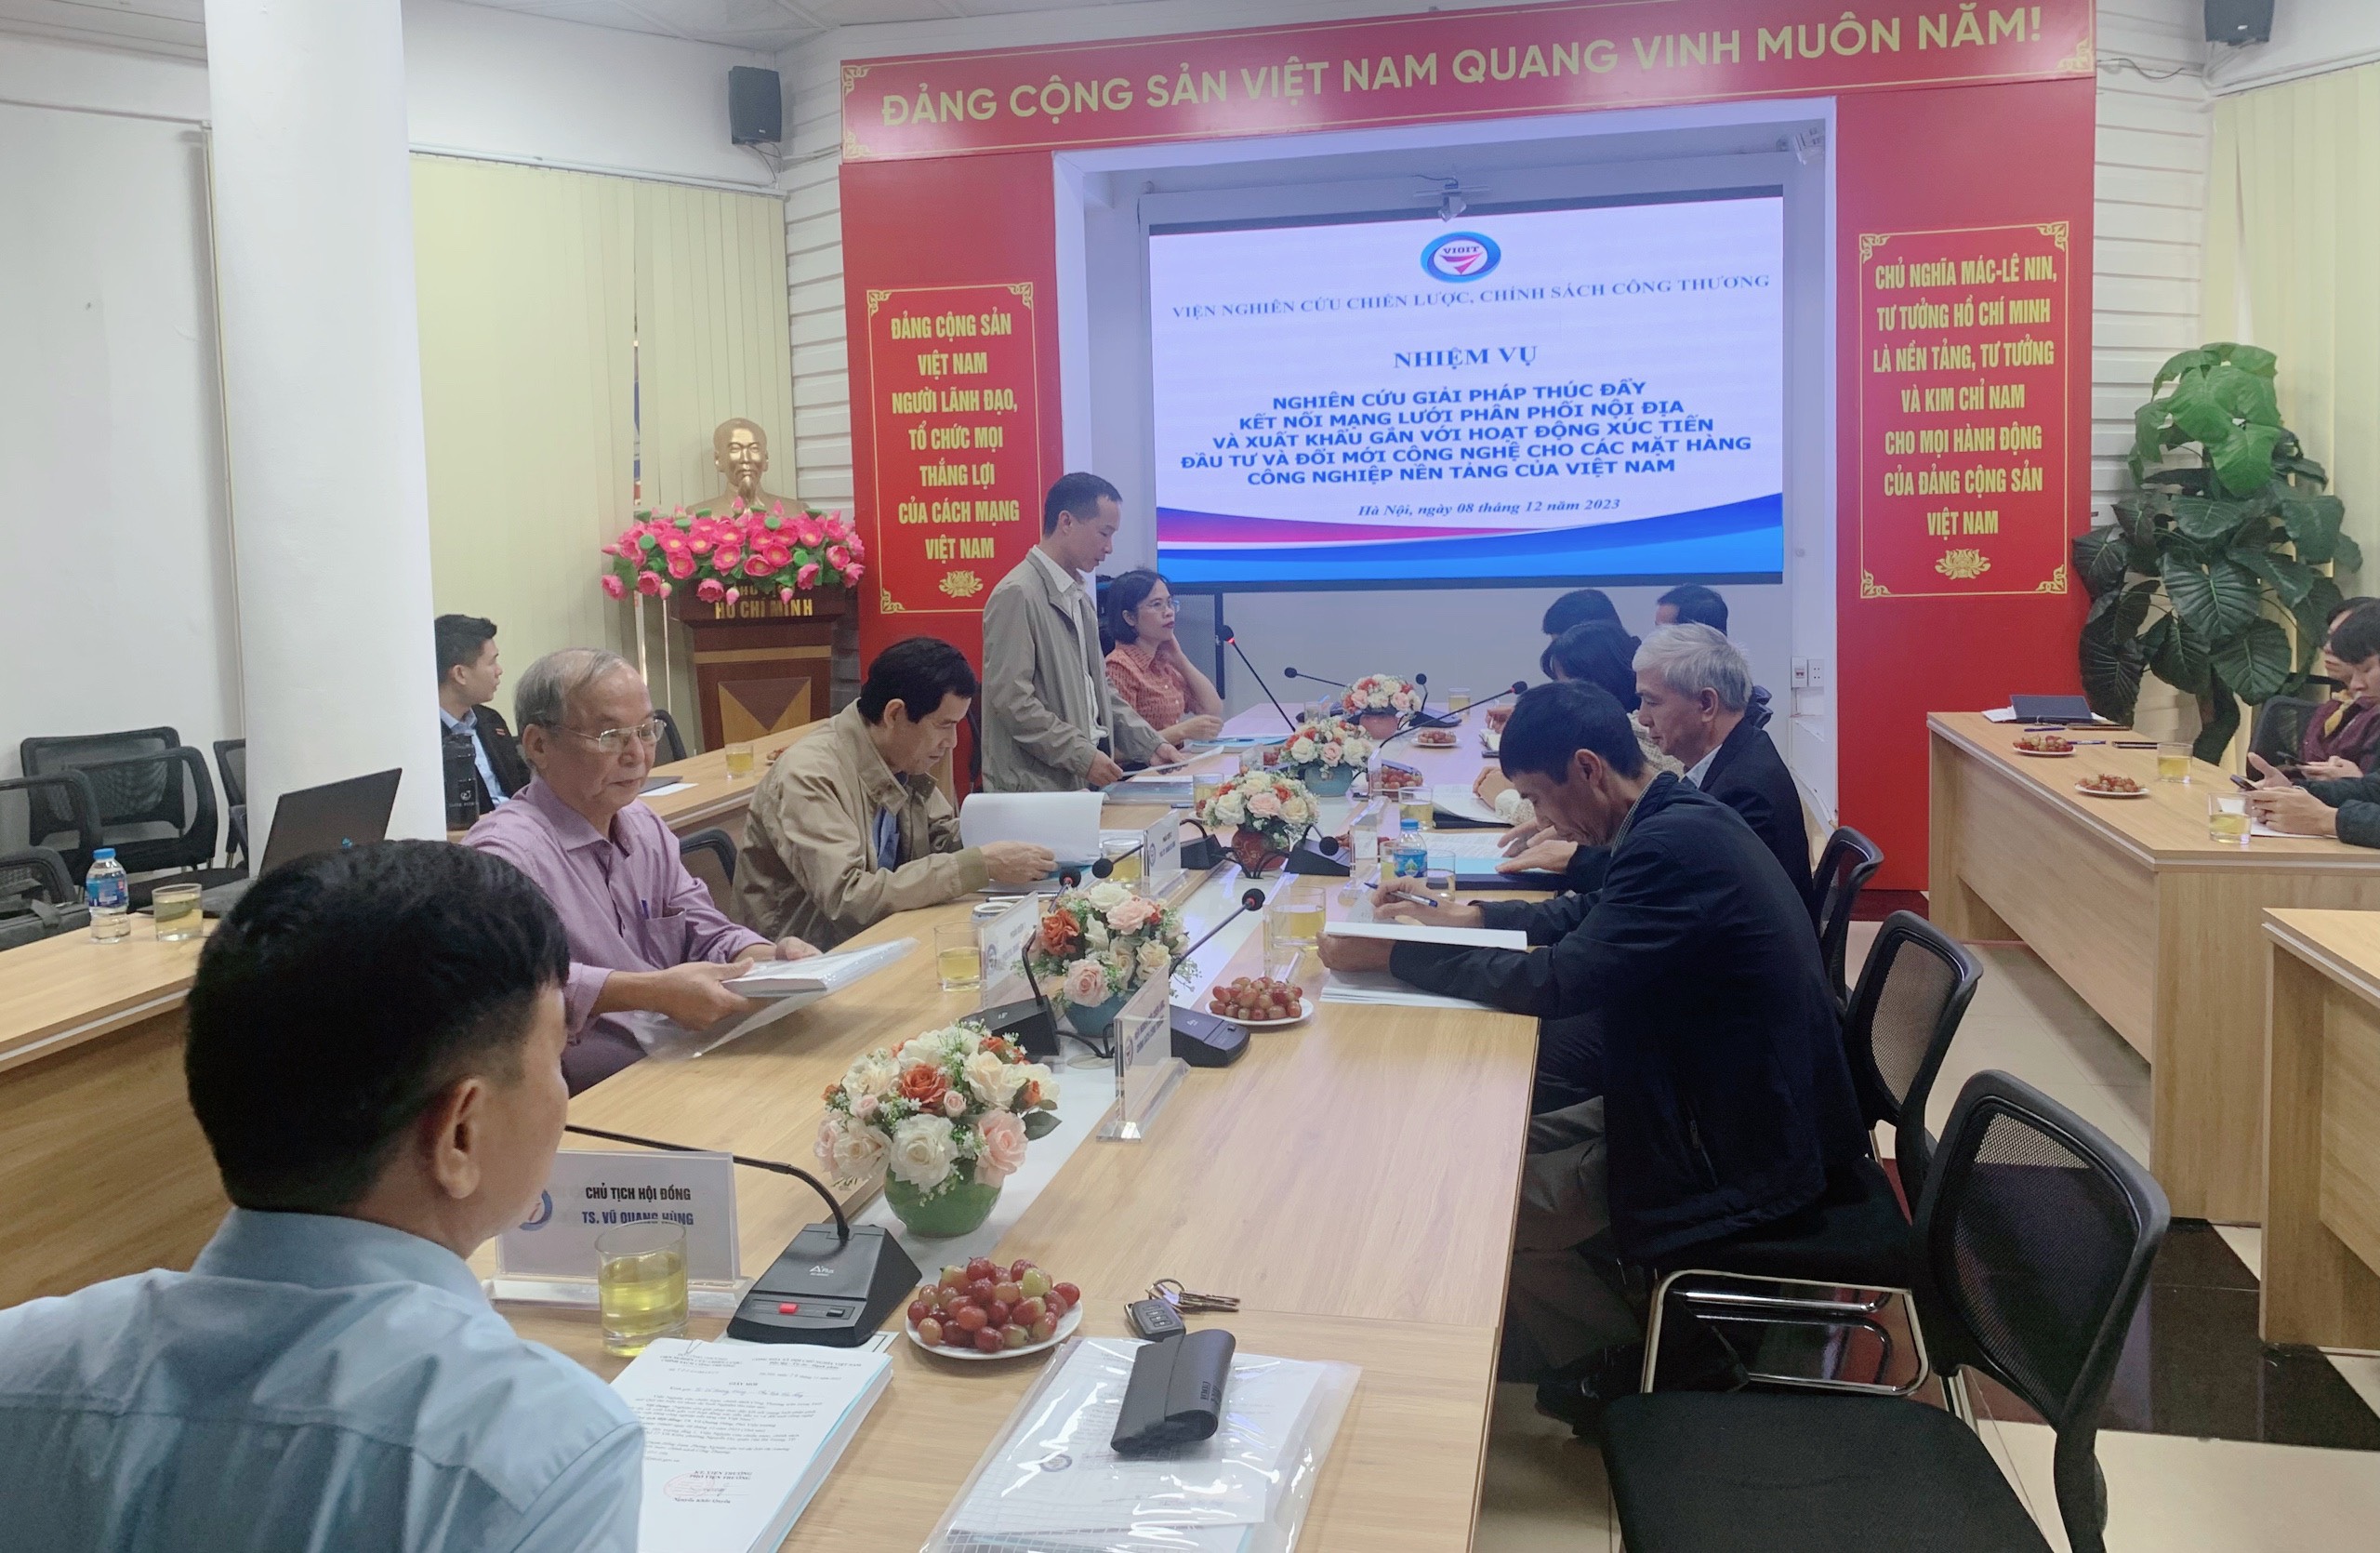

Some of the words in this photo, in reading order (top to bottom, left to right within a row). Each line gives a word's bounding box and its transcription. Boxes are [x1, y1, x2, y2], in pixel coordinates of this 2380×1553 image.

[881, 83, 998, 126] ĐẢNG
[1010, 74, 1133, 125] CỘNG
[1146, 62, 1227, 107] SẢN
[1241, 56, 1329, 107] VIỆT
[1342, 52, 1438, 93] NAM
[1452, 38, 1619, 85] QUANG
[1633, 30, 1740, 70] VINH
[1757, 12, 1901, 61] MUÔN
[1917, 3, 2043, 51] NĂM!
[1875, 256, 1906, 290] CHỦ
[1910, 261, 1957, 288] NGHĨA
[1961, 253, 2019, 285] MÁC-LÊ
[2024, 255, 2056, 283] NIN,
[1172, 304, 1216, 320] VIỆN
[1222, 299, 1295, 316] NGHIÊN
[1301, 296, 1342, 312] CỨU
[1480, 285, 1544, 302] CHÍNH
[1551, 283, 1605, 299] SÁCH
[1612, 278, 1671, 295] CÔNG
[1677, 274, 1770, 291] THƯƠNG
[1877, 304, 1897, 332] TƯ
[1899, 298, 1950, 330] TƯỞNG
[1953, 294, 1974, 328] HỒ
[1978, 296, 2005, 326] CHÍ
[2009, 298, 2051, 325] MINH
[891, 311, 931, 339] ĐẢNG
[935, 312, 976, 342] CỘNG
[981, 306, 1012, 337] SẢN
[918, 350, 948, 380] VIỆT
[953, 352, 987, 375] NAM
[1394, 346, 1490, 369] NHIỆM
[1498, 345, 1538, 366] VỤ
[1873, 343, 1891, 374] LÀ
[1896, 339, 1926, 372] NỀN
[1931, 335, 1976, 372] TẢNG,
[1980, 340, 2002, 368] TƯ
[2003, 334, 2055, 367] TƯỞNG
[892, 387, 937, 415] NGƯỜI
[941, 388, 980, 413] LÃNH
[984, 389, 1018, 416] ĐẠO,
[1273, 392, 1355, 409] NGHIÊN
[1361, 389, 1406, 406] CỨU
[1412, 386, 1462, 404] GIẢI
[1469, 384, 1527, 402] PHÁP
[1533, 380, 1593, 399] THÚC
[1600, 378, 1646, 396] ĐẨY
[1901, 384, 1921, 413] VÀ
[1925, 387, 1954, 412] KIM
[1959, 378, 1985, 411] CHỈ
[1989, 383, 2025, 409] NAM
[1239, 413, 1277, 430] KẾT
[1283, 410, 1324, 429] NỐI
[1329, 413, 1392, 430] MẠNG
[1397, 407, 1452, 425] LƯỚI
[1460, 404, 1520, 421] PHÂN
[1527, 400, 1584, 419] PHỐI
[1591, 398, 1634, 418] NỘI
[1641, 400, 1685, 416] ĐỊA
[908, 420, 927, 450] TỔ
[931, 423, 970, 450] CHỨC
[974, 426, 1003, 453] MỌI
[1212, 432, 1239, 449] VÀ
[1246, 431, 1299, 448] XUẤT
[1305, 428, 1362, 446] KHẨU
[1421, 426, 1461, 442] VỚI
[1469, 426, 1528, 444] HOẠT
[1535, 421, 1600, 442] ĐỘNG
[1606, 417, 1652, 436] XÚC
[1659, 414, 1713, 432] TIẾN
[1884, 431, 1915, 456] CHO
[1920, 429, 1949, 458] MỌI
[1953, 423, 1995, 453] HÀNH
[2000, 420, 2042, 456] ĐỘNG
[1228, 452, 1258, 467] TƯ
[1263, 449, 1289, 466] VÀ
[1342, 445, 1386, 463] MỚI
[1393, 445, 1453, 462] CÔNG
[1461, 442, 1520, 461] NGHỆ
[1527, 443, 1574, 458] CHO
[1580, 438, 1624, 456] CÁC
[1632, 436, 1679, 457] MẶT
[1686, 433, 1752, 452] HÀNG
[919, 457, 968, 487] THẮNG
[972, 463, 995, 490] LỢI
[1247, 468, 1305, 484] CÔNG
[1312, 464, 1394, 485] NGHIỆP
[1399, 463, 1443, 481] NỀN
[1450, 460, 1508, 479] TẢNG
[1514, 459, 1559, 477] CỦA
[1566, 458, 1618, 478] VIỆT
[1624, 459, 1675, 473] NAM
[1884, 463, 1914, 497] CỦA
[1918, 462, 1961, 496] ĐẢNG
[1964, 465, 2006, 498] CỘNG
[2011, 459, 2043, 492] SẢN
[898, 496, 928, 524] CỦA
[932, 498, 971, 524] CÁCH
[975, 499, 1020, 526] MẠNG
[1357, 505, 1380, 516] Hà
[1384, 504, 1412, 517] Nội,
[1418, 503, 1452, 517] ngày
[1457, 503, 1474, 513] 08
[1478, 502, 1519, 515] tháng
[1526, 500, 1542, 511] 12
[1547, 499, 1580, 511] năm
[1584, 498, 1620, 511] 2023
[1926, 508, 1959, 540] VIỆT
[1963, 510, 1999, 535] NAM
[925, 535, 956, 564] VIỆT
[960, 538, 994, 560] NAM
[771, 599, 813, 617] MINH
[586, 1182, 608, 1200] CHỦ
[610, 1187, 635, 1202] TỊCH
[638, 1185, 657, 1202] HỘI
[582, 1212, 600, 1224] TS.
[602, 1210, 616, 1224] VŨ
